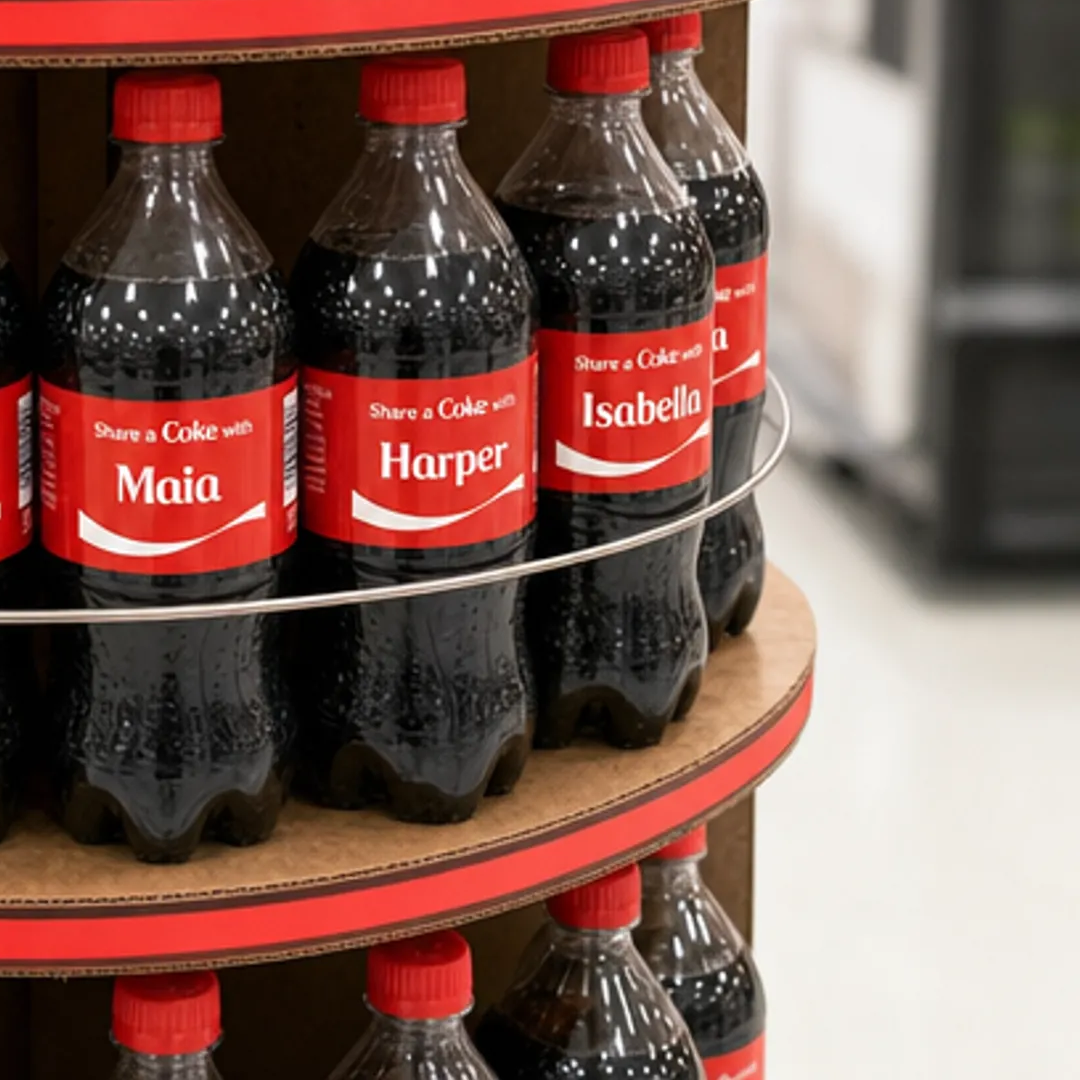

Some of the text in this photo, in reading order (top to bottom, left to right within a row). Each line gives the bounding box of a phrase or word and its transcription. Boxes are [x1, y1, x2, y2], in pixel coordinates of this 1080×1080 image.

[574, 355, 619, 372] Share
[637, 346, 679, 370] Coke
[369, 402, 417, 420] Share
[422, 406, 432, 419] a
[437, 395, 488, 420] Coke
[582, 384, 701, 428] Isabella
[94, 421, 140, 443] Share
[162, 420, 218, 443] Coke
[380, 441, 509, 487] Harper
[116, 463, 222, 505] Maia
